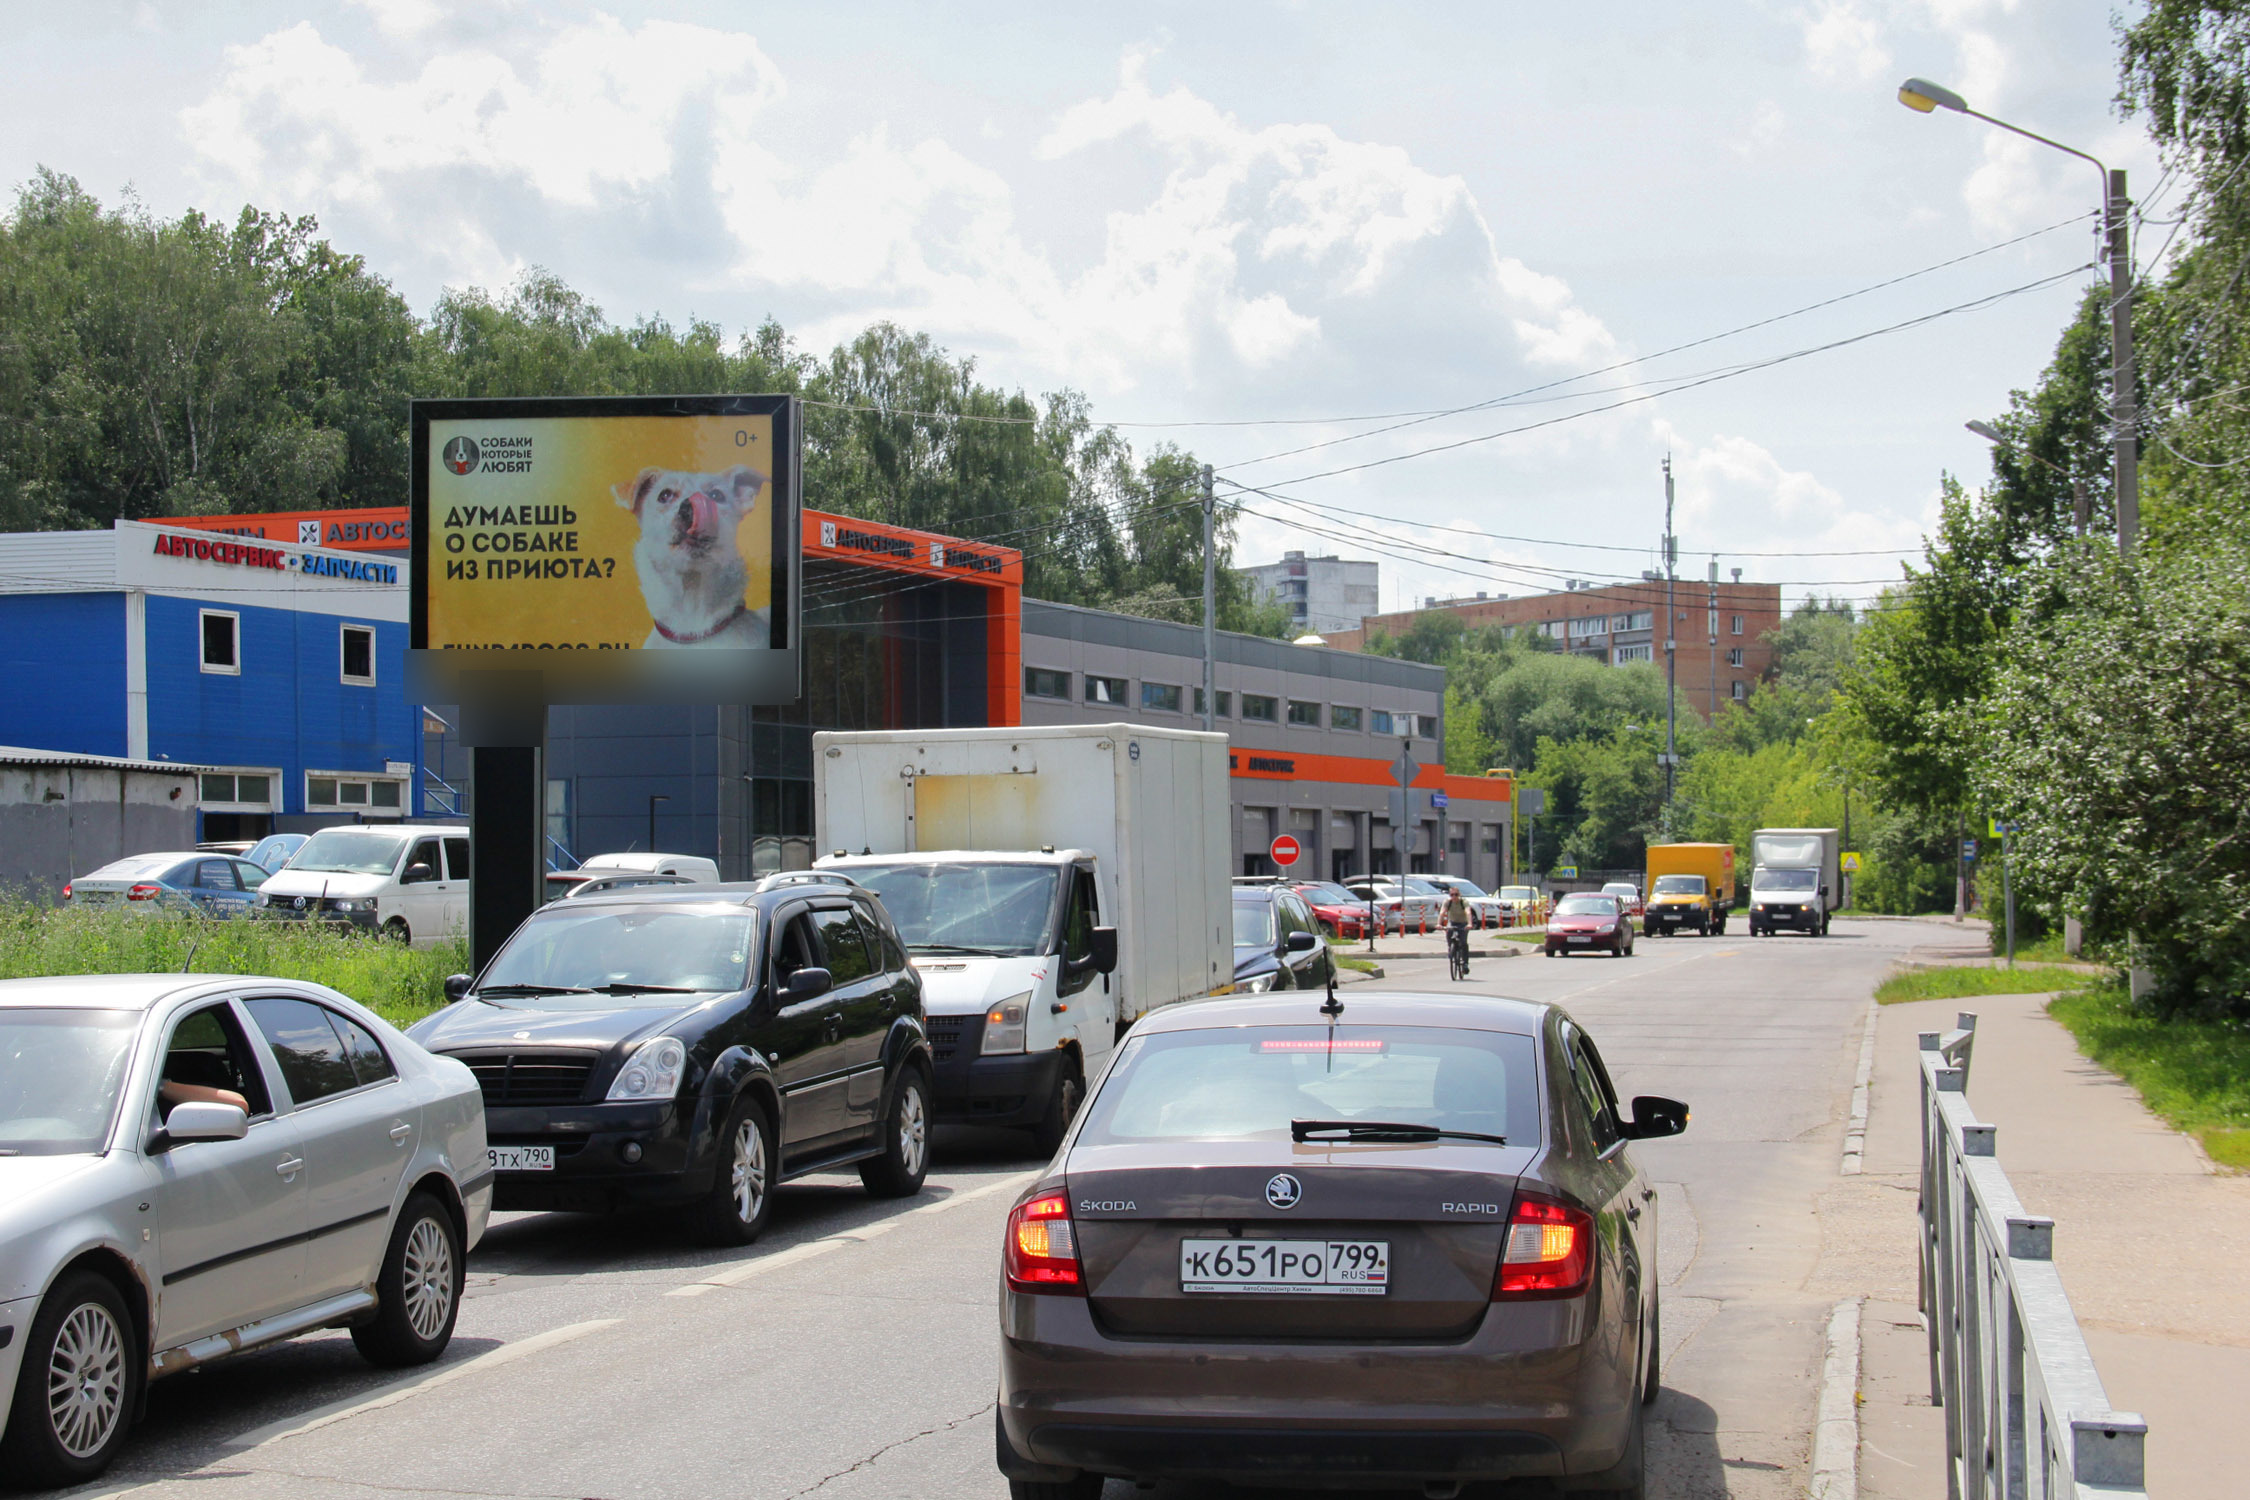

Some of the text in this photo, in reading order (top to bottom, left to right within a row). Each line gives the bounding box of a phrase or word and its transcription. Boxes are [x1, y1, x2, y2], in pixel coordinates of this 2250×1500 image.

[480, 437, 532, 448] СОБАКИ
[735, 430, 757, 447] 0+
[481, 449, 532, 459] КОТОРЫЕ
[480, 460, 532, 473] ЛЮБЯТ
[444, 504, 577, 528] ДУМАЕШЬ
[446, 531, 578, 553] О СОБАКЕ
[837, 527, 915, 558] АВТОСЕРВИС
[154, 534, 398, 584] АВТОСЕРВИС ЗАПЧАСТИ
[447, 557, 616, 580] ИЗ ПРИЮТА?
[523, 1148, 549, 1162] 790
[1080, 1199, 1137, 1212] ŠKODA
[1442, 1202, 1498, 1214] RAPID
[1329, 1244, 1379, 1269] 799
[1341, 1270, 1366, 1280] RUS
